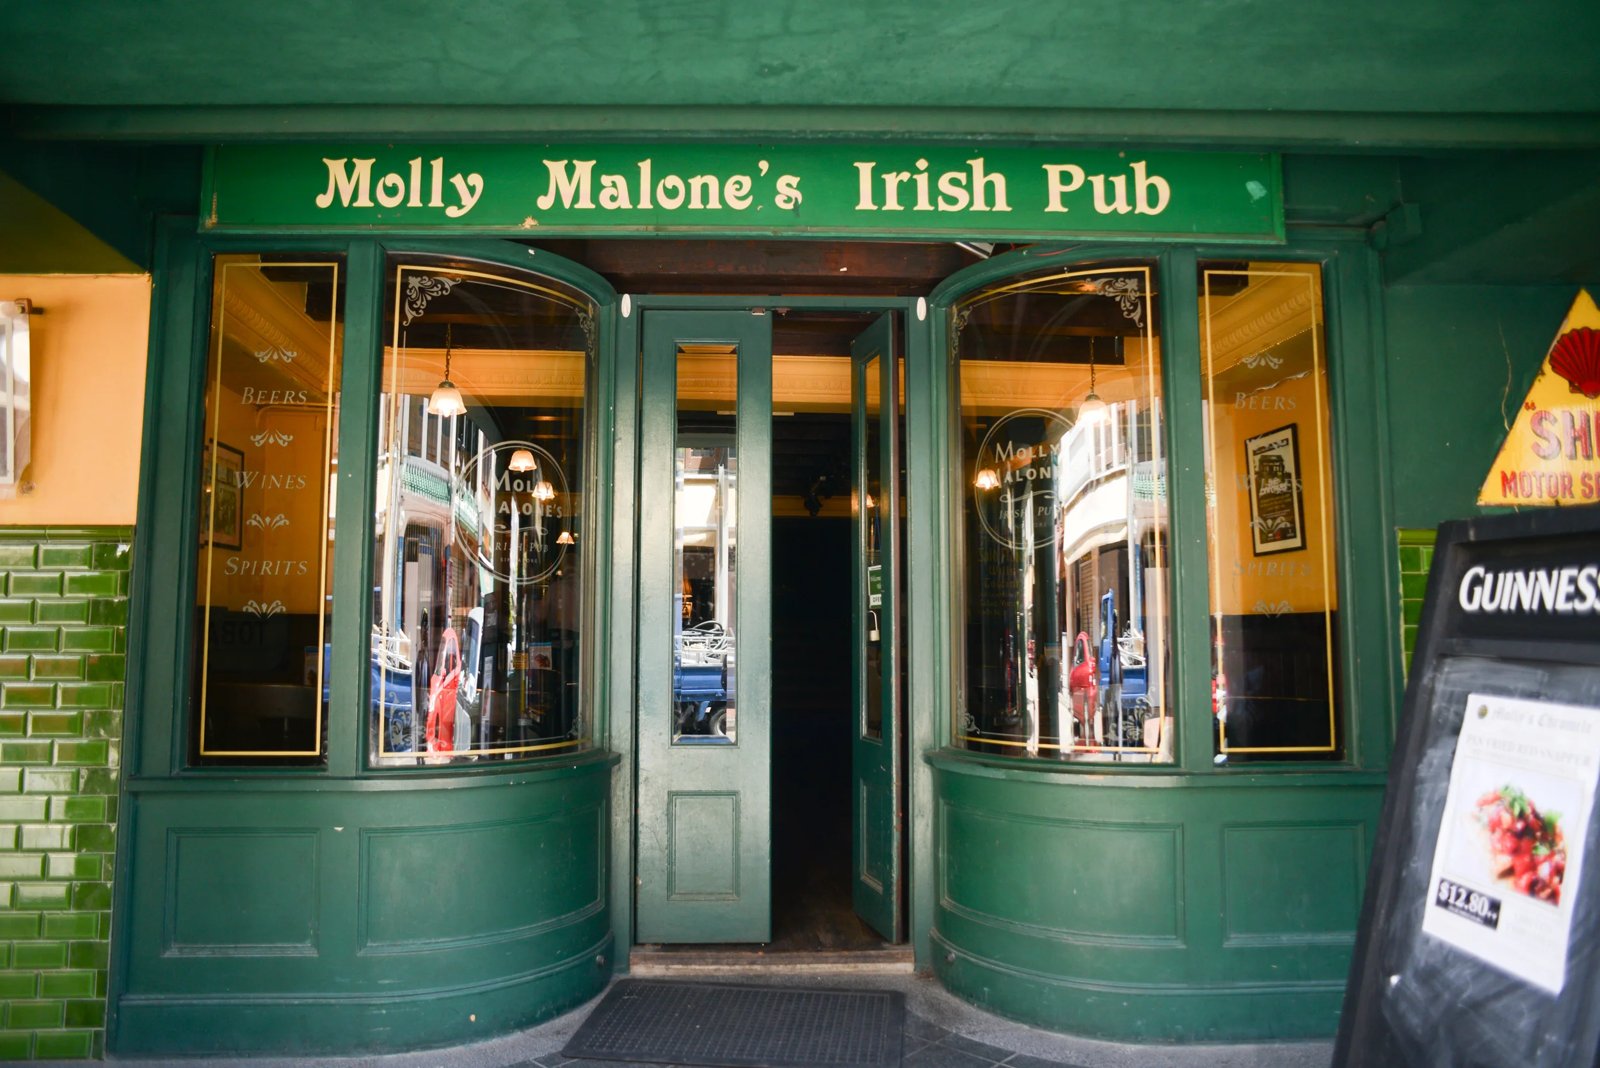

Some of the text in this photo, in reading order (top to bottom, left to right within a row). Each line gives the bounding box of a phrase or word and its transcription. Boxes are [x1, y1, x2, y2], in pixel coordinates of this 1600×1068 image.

[315, 156, 1172, 218] Molly Malone's Irish Pub
[240, 387, 308, 405] BEERS
[234, 471, 307, 489] WINES
[1501, 470, 1575, 499] MOTOR
[224, 556, 308, 576] SPIRITS
